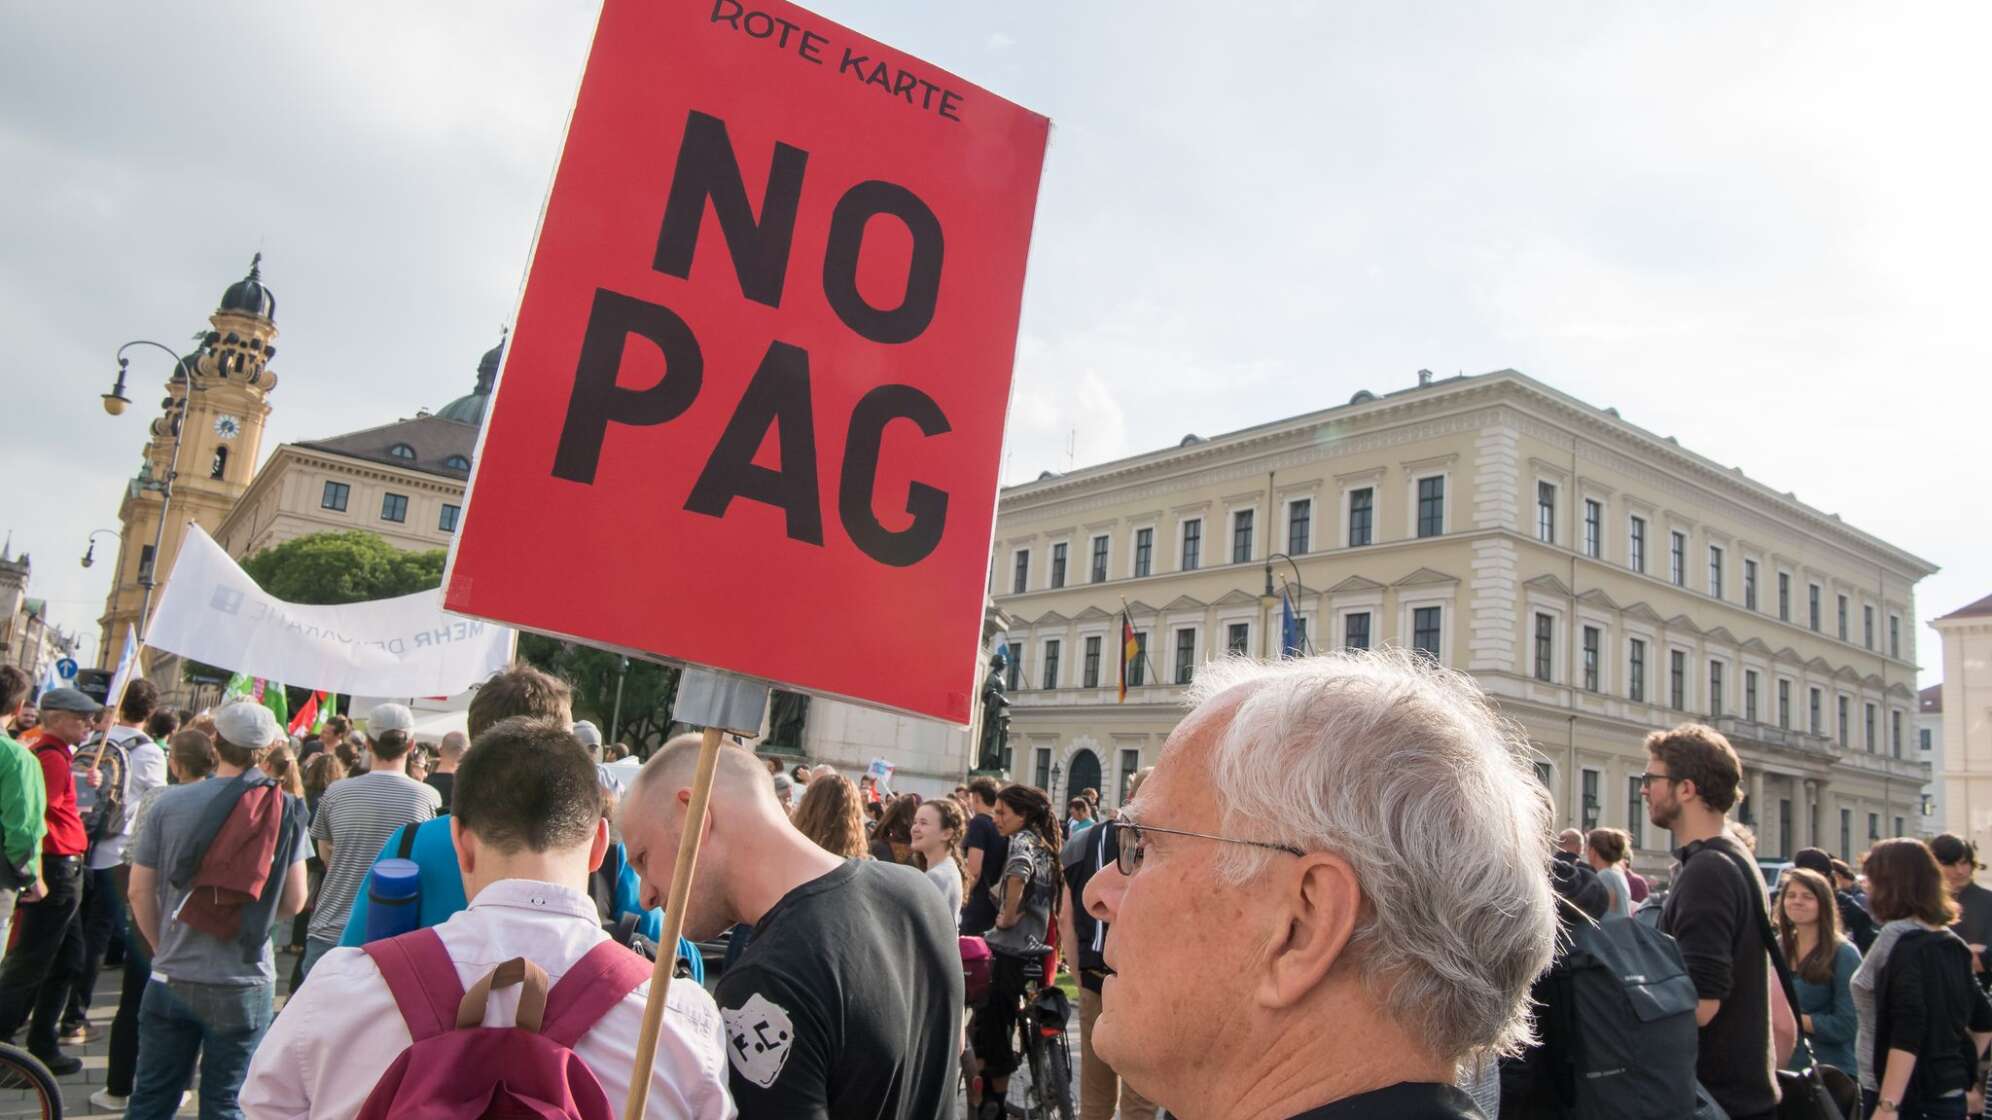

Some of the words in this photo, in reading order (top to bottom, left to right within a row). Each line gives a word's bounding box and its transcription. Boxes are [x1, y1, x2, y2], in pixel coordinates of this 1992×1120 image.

[710, 0, 830, 65] ROTE
[839, 47, 964, 123] KARTE
[651, 108, 945, 345] NO
[551, 287, 953, 568] PAG
